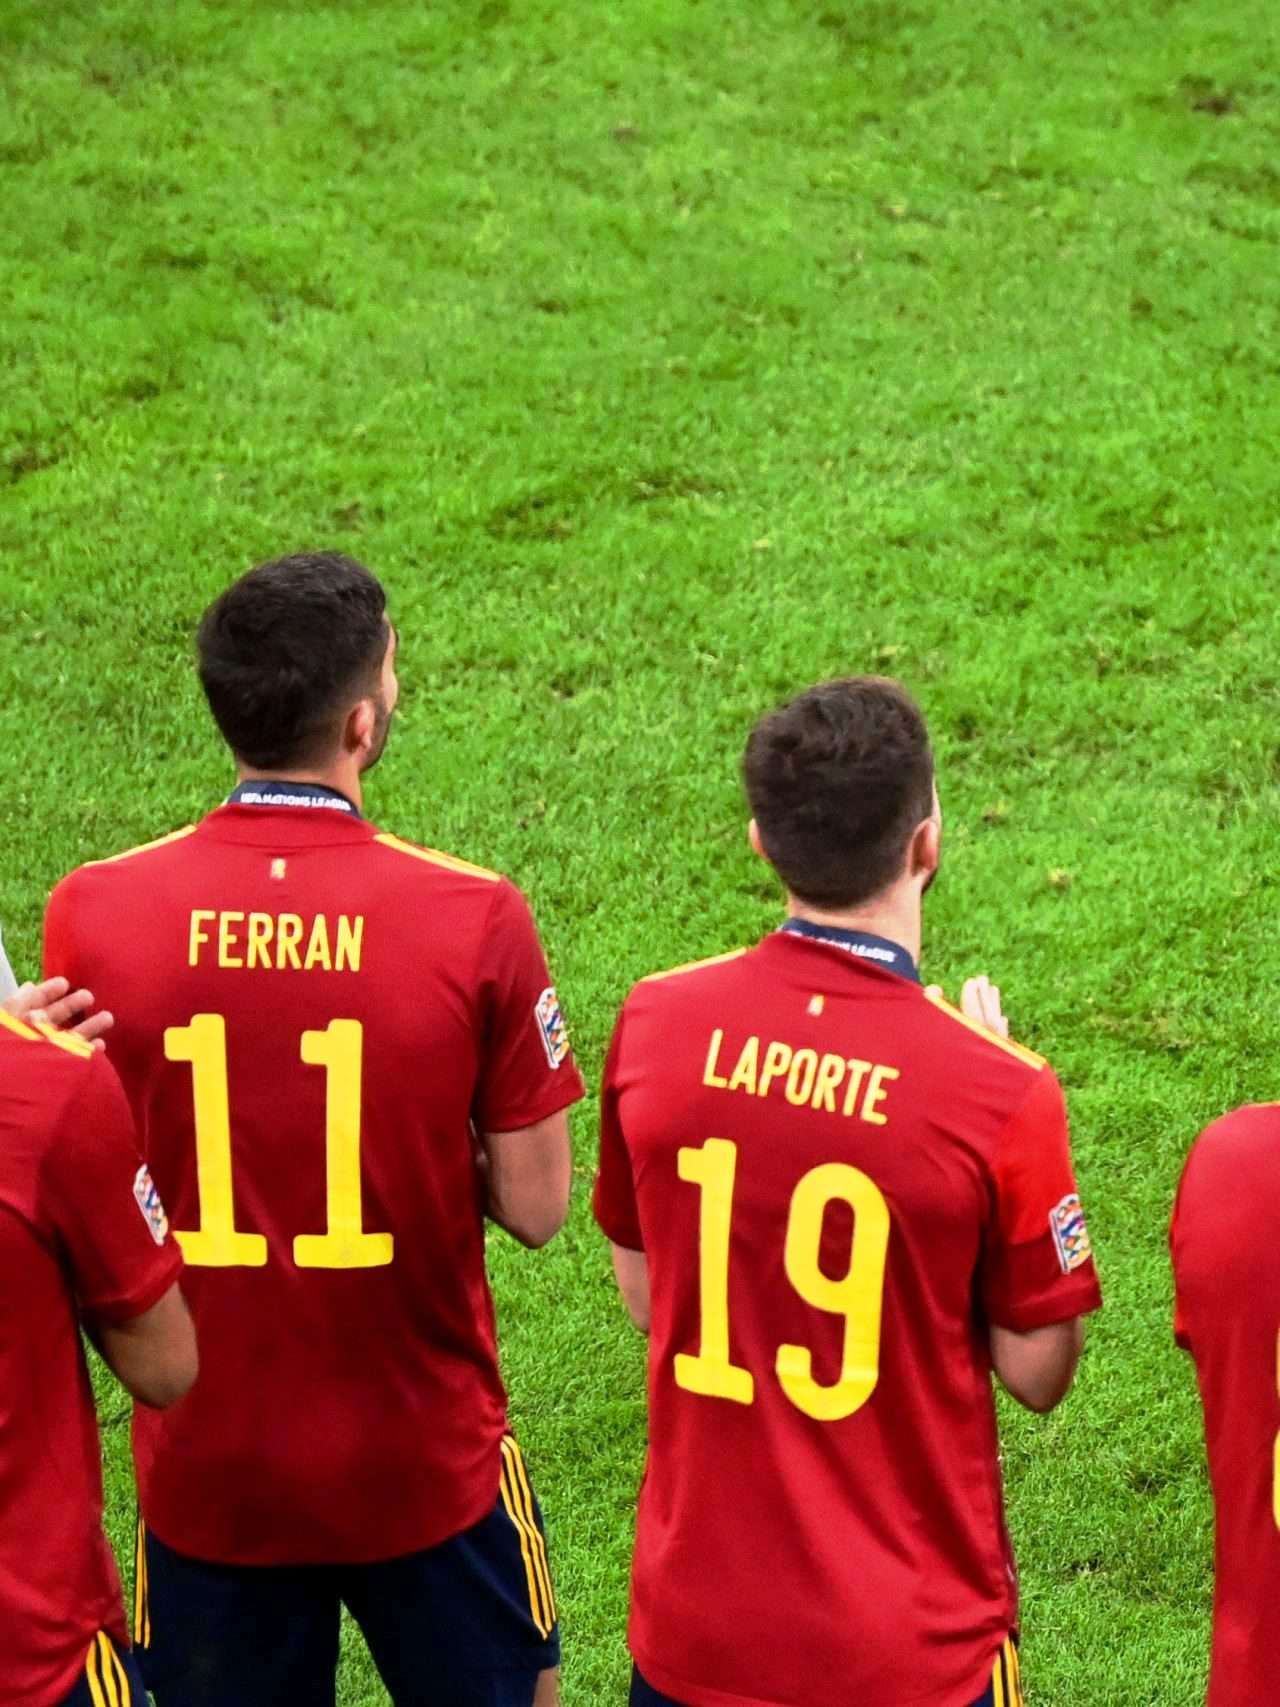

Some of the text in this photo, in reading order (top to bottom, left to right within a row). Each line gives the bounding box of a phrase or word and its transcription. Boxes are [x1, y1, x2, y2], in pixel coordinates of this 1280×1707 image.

[188, 909, 364, 972] FERRAN
[163, 1013, 394, 1269] 11
[703, 1028, 900, 1126] LAPORTE
[673, 1137, 891, 1421] 19
